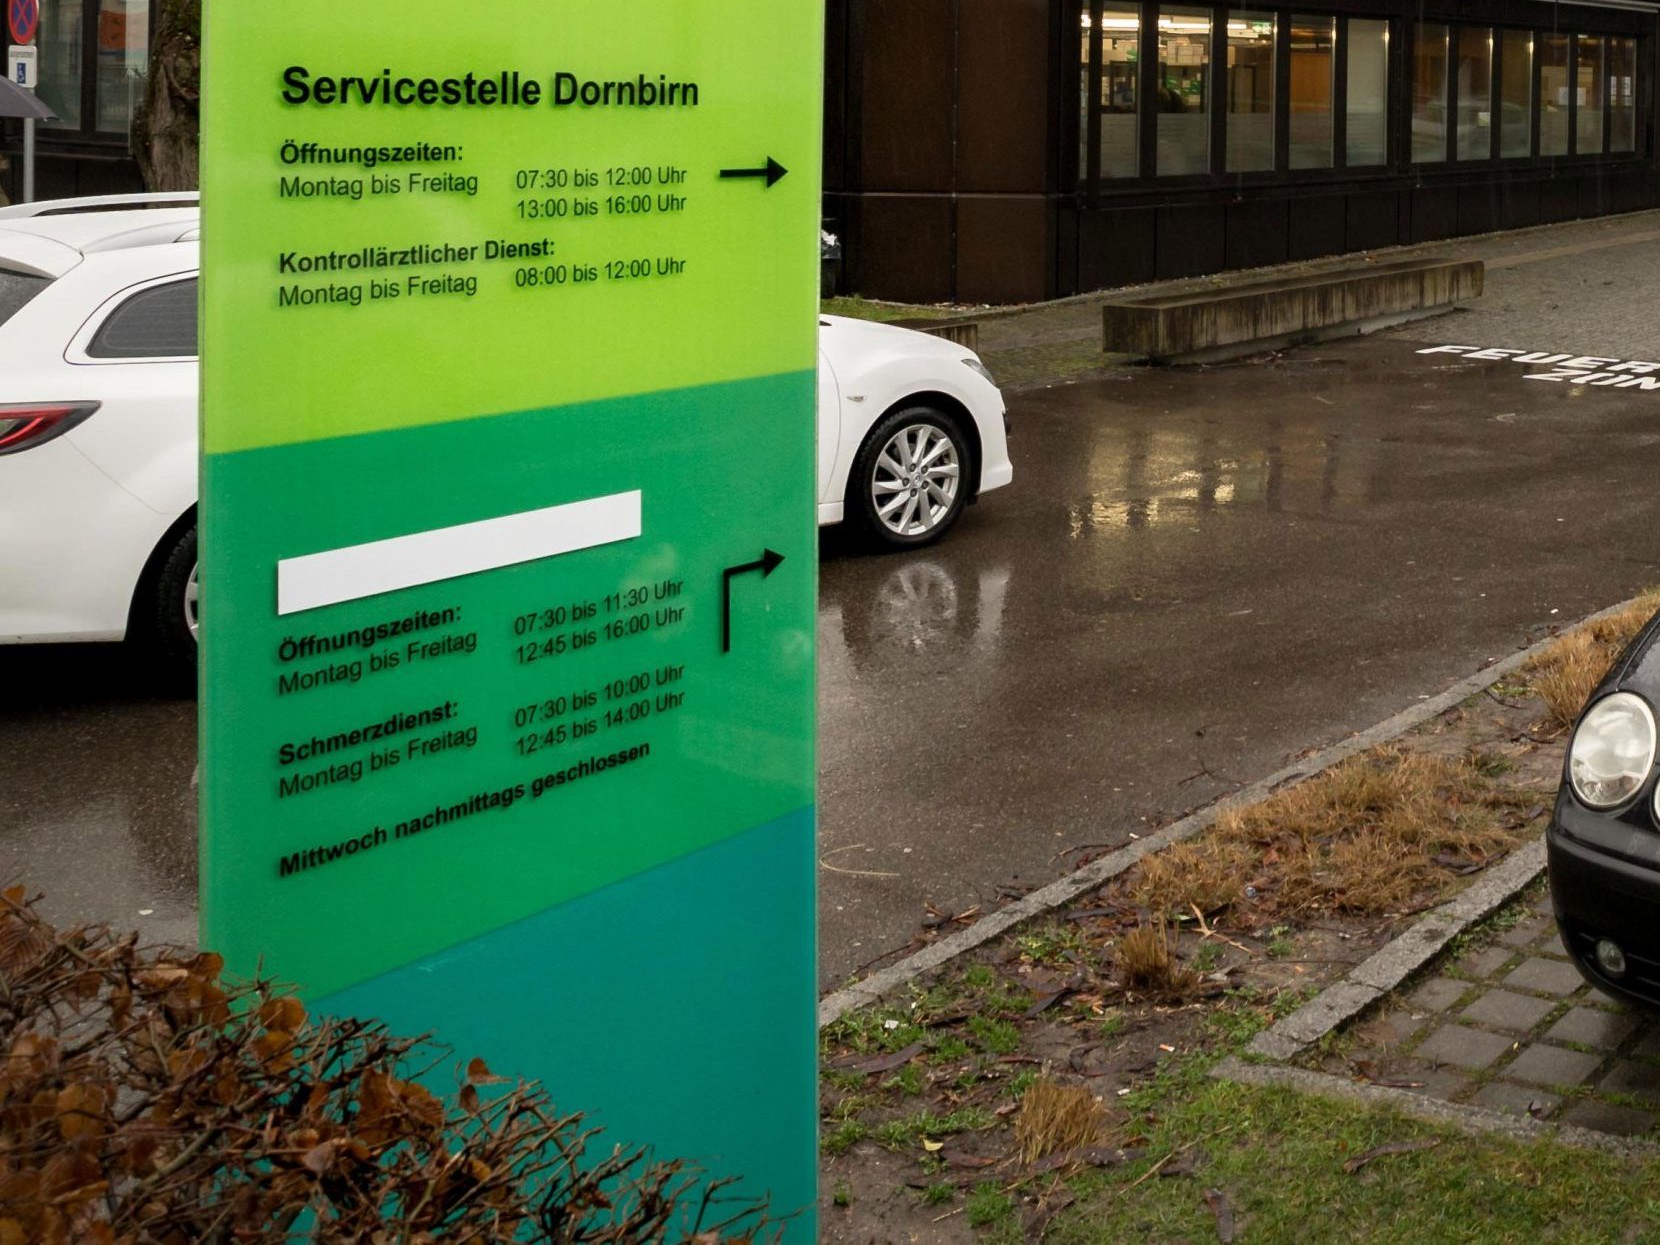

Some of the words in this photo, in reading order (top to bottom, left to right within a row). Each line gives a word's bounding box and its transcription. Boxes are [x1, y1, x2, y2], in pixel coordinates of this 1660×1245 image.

[281, 66, 542, 106] Servicestelle
[554, 71, 699, 106] Dornbirn
[280, 138, 464, 167] Öffnungszeiten:
[280, 176, 363, 200] Montag
[371, 174, 401, 194] bis
[408, 172, 479, 195] Freitag
[516, 169, 568, 189] 07:30
[574, 168, 599, 187] bis
[606, 167, 652, 186] 12:00
[658, 165, 688, 184] Uhr
[517, 197, 568, 219] 13:00
[574, 196, 599, 216] bis
[606, 195, 652, 215] 16:00
[658, 193, 688, 212] Uhr
[279, 242, 479, 274] Kontrollärztlicher
[485, 237, 556, 259] Dienst:
[279, 281, 363, 307] Montag
[371, 276, 401, 299] bis
[408, 273, 478, 296] Freitag
[515, 265, 567, 287] 08:00
[573, 262, 598, 282] bis
[605, 260, 651, 279] 12:00
[657, 257, 687, 276] Uhr
[278, 605, 462, 663] Öffnungszeiten:
[278, 656, 363, 697] Montag
[370, 649, 401, 673] bis
[407, 630, 478, 663] Freitag
[514, 606, 567, 636] 07:30
[572, 600, 597, 621] bis
[604, 588, 649, 613] 11:30
[654, 579, 684, 601] Uhr
[516, 634, 567, 665] 12:45
[572, 628, 597, 649] bis
[604, 615, 650, 641] 16:00
[655, 606, 686, 628] Uhr
[278, 755, 363, 799] Montag
[370, 744, 401, 772] bis
[407, 725, 478, 760] Freitag
[514, 697, 567, 728] 07:30
[572, 689, 597, 710] bis
[604, 676, 650, 702] 10:00
[655, 664, 686, 687] Uhr
[279, 699, 459, 767] Schmerzdienst:
[516, 725, 567, 757] 12:45
[572, 716, 597, 739] bis
[604, 703, 650, 730] 14:00
[655, 691, 686, 714] Uhr
[279, 826, 388, 878] Mittwoch
[394, 784, 526, 839] nachmittags
[531, 742, 650, 798] geschlossen
